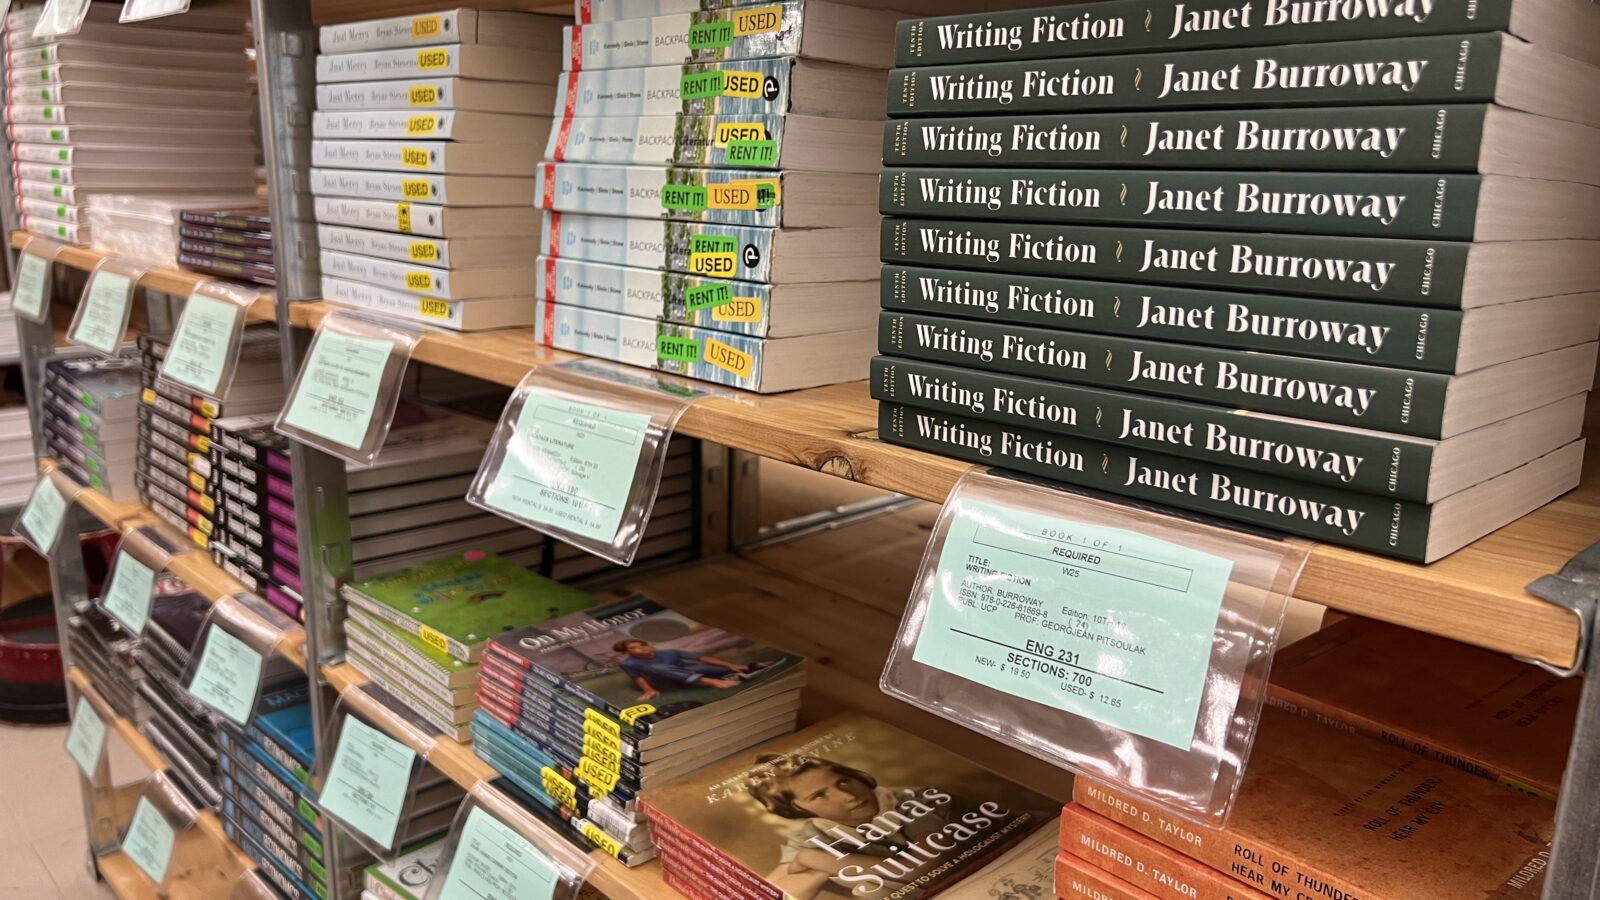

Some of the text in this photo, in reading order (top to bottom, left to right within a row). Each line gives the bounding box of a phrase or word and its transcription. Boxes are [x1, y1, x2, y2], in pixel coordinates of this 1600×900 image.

[415, 19, 438, 35] USED
[692, 24, 731, 44] RENT IT!
[738, 13, 777, 32] USED
[937, 22, 1022, 50] Writing
[1032, 13, 1123, 43] Fiction
[1169, 2, 1252, 39] Janet
[1264, 0, 1432, 25] Burroway
[655, 34, 689, 47] BACKPAC
[420, 53, 445, 67] USED
[1454, 40, 1470, 91] CHICAGO
[647, 88, 680, 101] BACKPAC
[684, 76, 721, 94] RENT IT!
[930, 59, 1428, 104] Writing Fiction Janet Burroway
[411, 89, 435, 103] USED
[409, 117, 434, 131] USED
[720, 129, 759, 143] USED
[1431, 109, 1447, 159] CHICAGO
[730, 143, 772, 161] RENT IT!
[921, 121, 1406, 157] Writing Fiction Janet Burroway
[405, 152, 428, 165] USED
[405, 182, 428, 196] USED
[666, 190, 704, 206] RENT IT!
[714, 188, 749, 205] USED
[920, 178, 1406, 225] Writing Fiction Janet Burroway
[1431, 179, 1447, 228] CHICAGO
[412, 243, 435, 257] USED
[695, 240, 720, 253] RENT
[695, 257, 732, 272] USED
[920, 229, 1396, 291] Writing Fiction Janet Burroway
[1421, 247, 1435, 295] CHICAGO
[409, 274, 431, 288] USED
[422, 300, 447, 314] USED
[689, 286, 729, 306] RENT IT!
[718, 302, 755, 317] USED
[919, 278, 1390, 354] Writing Fiction Janet Burroway
[1416, 313, 1430, 360] CHICAGO
[661, 342, 697, 359] RENT IT!
[710, 344, 745, 371] USED
[916, 324, 1376, 416] Writing Fiction Janet Burroway
[1401, 377, 1414, 424] CHICAGO
[908, 374, 1363, 482] Writing Fiction Janet Burroway
[917, 415, 1365, 535] Writing Fiction Janet Burroway
[1388, 447, 1401, 492] CHICAGO
[1390, 502, 1401, 546] CHICAGO
[1042, 528, 1073, 541] BOOK
[1093, 539, 1108, 549] OF
[968, 555, 991, 567] TITLE:
[1052, 546, 1101, 565] REQUIRED
[1062, 566, 1080, 578] W25
[980, 594, 1048, 618] 978-0-226-61669-8
[997, 589, 1044, 607] BURROWAY
[1062, 606, 1090, 620] Edition:
[423, 629, 447, 649] USED
[519, 634, 555, 650] On
[552, 626, 591, 641] My
[583, 607, 648, 631] Honor
[981, 602, 998, 613] UCP
[1041, 619, 1095, 641] GEORGJEAN
[1096, 634, 1147, 656] PITSOULAK
[1025, 639, 1080, 665] ENG 231
[975, 655, 997, 668] NEW-
[1010, 666, 1031, 679] 19.50
[1007, 652, 1093, 687] SECTIONS: 700
[1060, 682, 1122, 708] USED- $ 12.65
[1380, 730, 1429, 756] ROLL OF
[583, 763, 613, 786] USED
[705, 769, 776, 804] KAREN
[806, 787, 953, 861] Hana's
[1087, 786, 1203, 848] MILDRED D. TAYLOR
[1362, 816, 1391, 832] ROLL
[1385, 805, 1402, 817] OF
[1390, 800, 1448, 842] HEAR MY CRY
[838, 800, 1011, 893] Suitcase
[916, 872, 931, 885] TO
[928, 860, 955, 879] SOLVE
[959, 831, 1003, 862] HOLOCAUST
[1001, 811, 1032, 835] MYSTERY
[1080, 834, 1198, 900] MILDRED D. TAYLOR
[1234, 844, 1264, 867] ROLL
[1271, 861, 1290, 877] OF
[1507, 857, 1547, 890] MILDRED
[1231, 862, 1291, 897] HEAR MY
